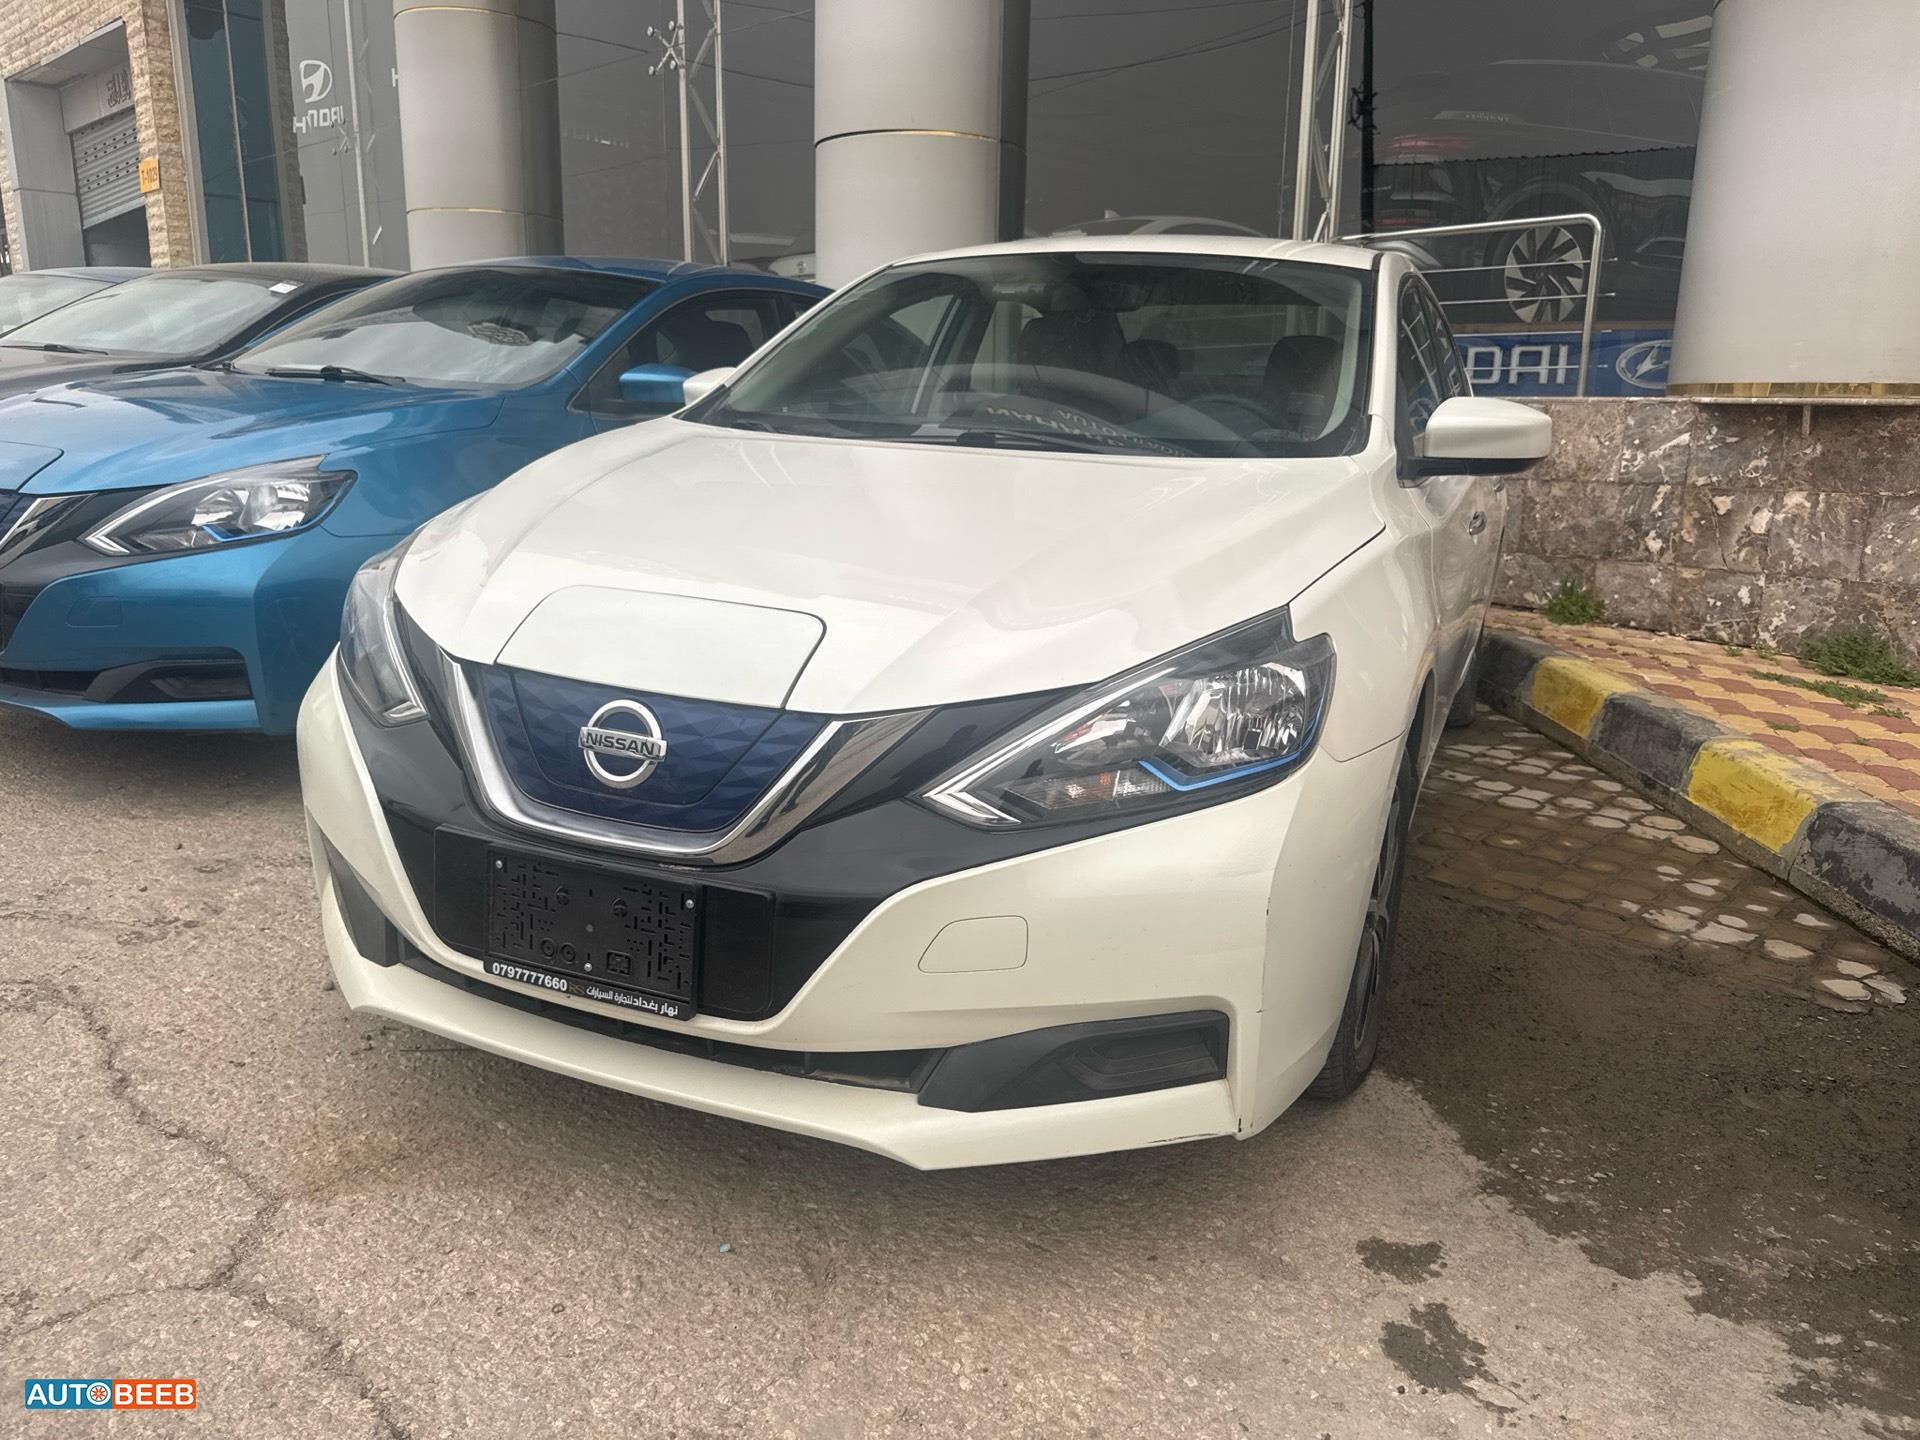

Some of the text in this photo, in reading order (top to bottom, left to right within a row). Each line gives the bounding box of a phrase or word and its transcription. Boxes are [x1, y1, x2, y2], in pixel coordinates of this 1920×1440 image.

[586, 732, 655, 755] NISSAN
[492, 962, 568, 991] 0797777660
[586, 986, 614, 1000] السيارات
[632, 996, 658, 1012] بغداد
[660, 1002, 679, 1017] نهار
